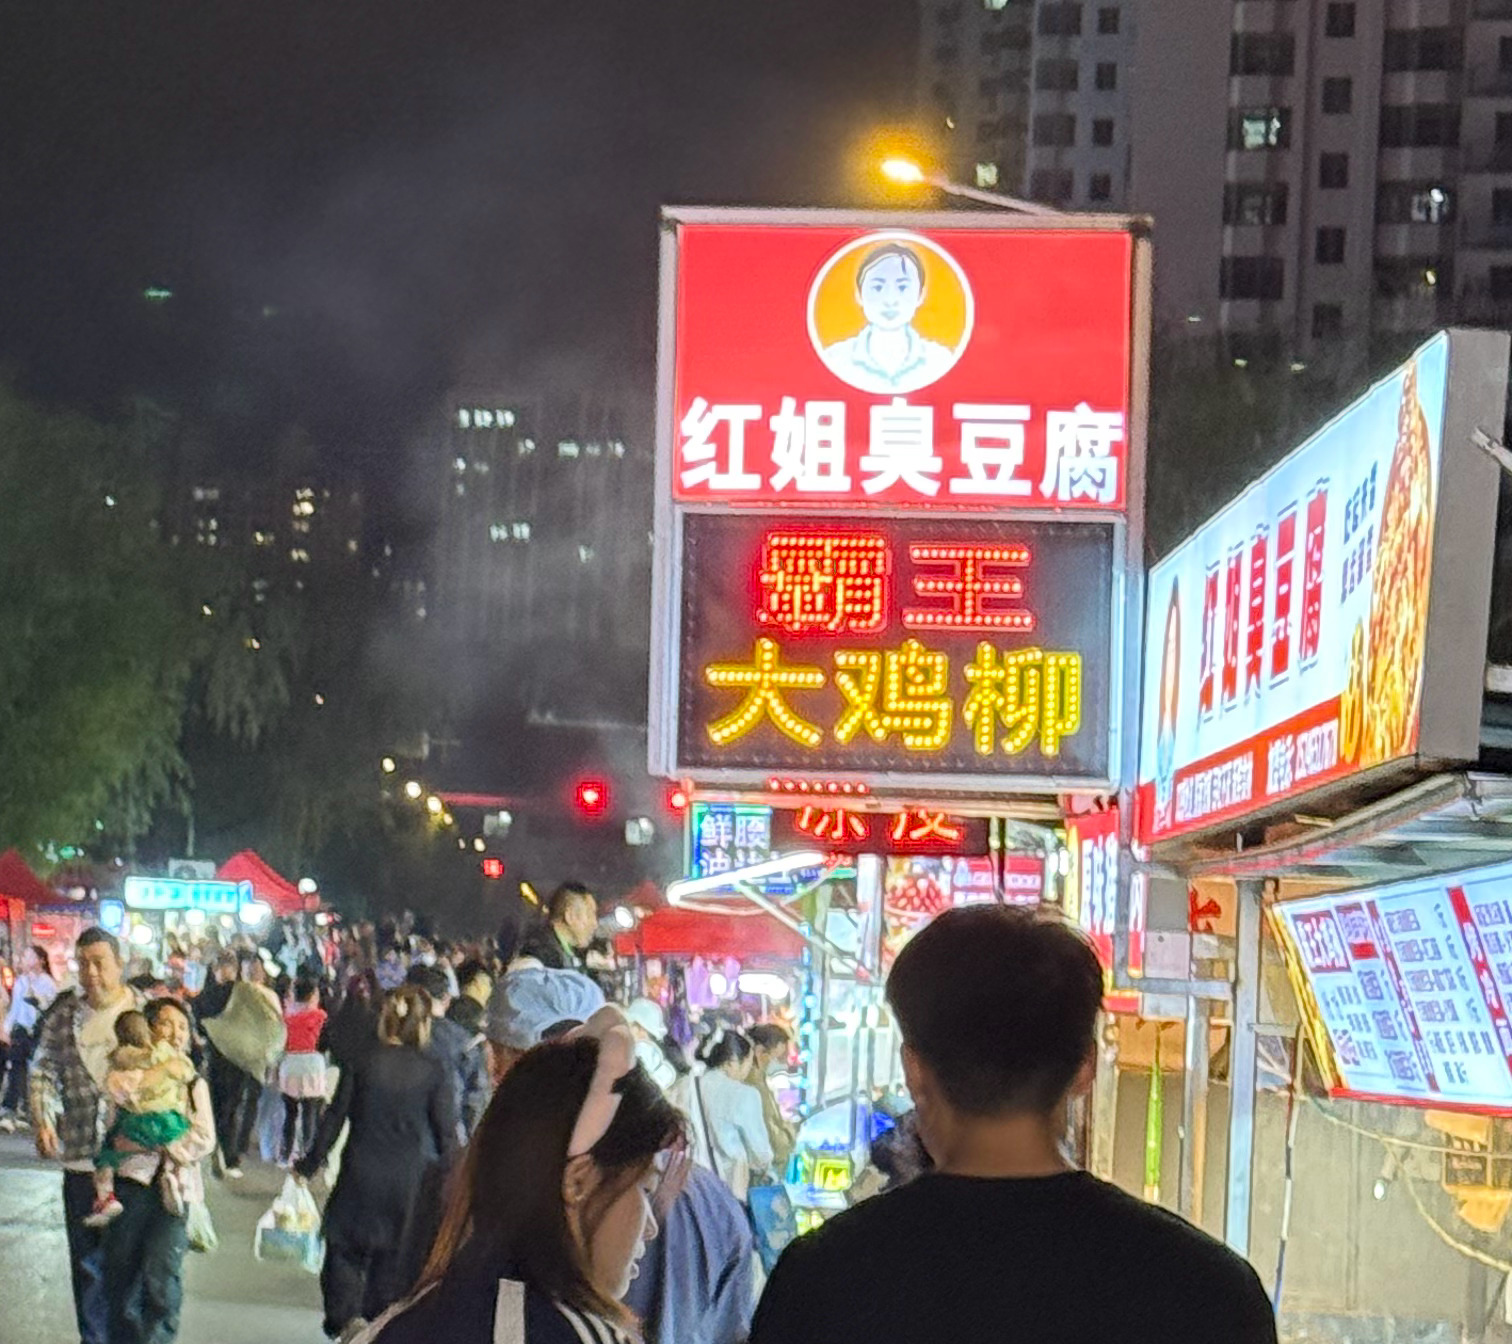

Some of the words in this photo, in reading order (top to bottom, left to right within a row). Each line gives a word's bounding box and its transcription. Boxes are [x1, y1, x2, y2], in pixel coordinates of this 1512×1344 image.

[679, 396, 1126, 502] 红姐臭豆腐
[757, 530, 1034, 633] 霸王
[704, 638, 1081, 756] 大鸡柳
